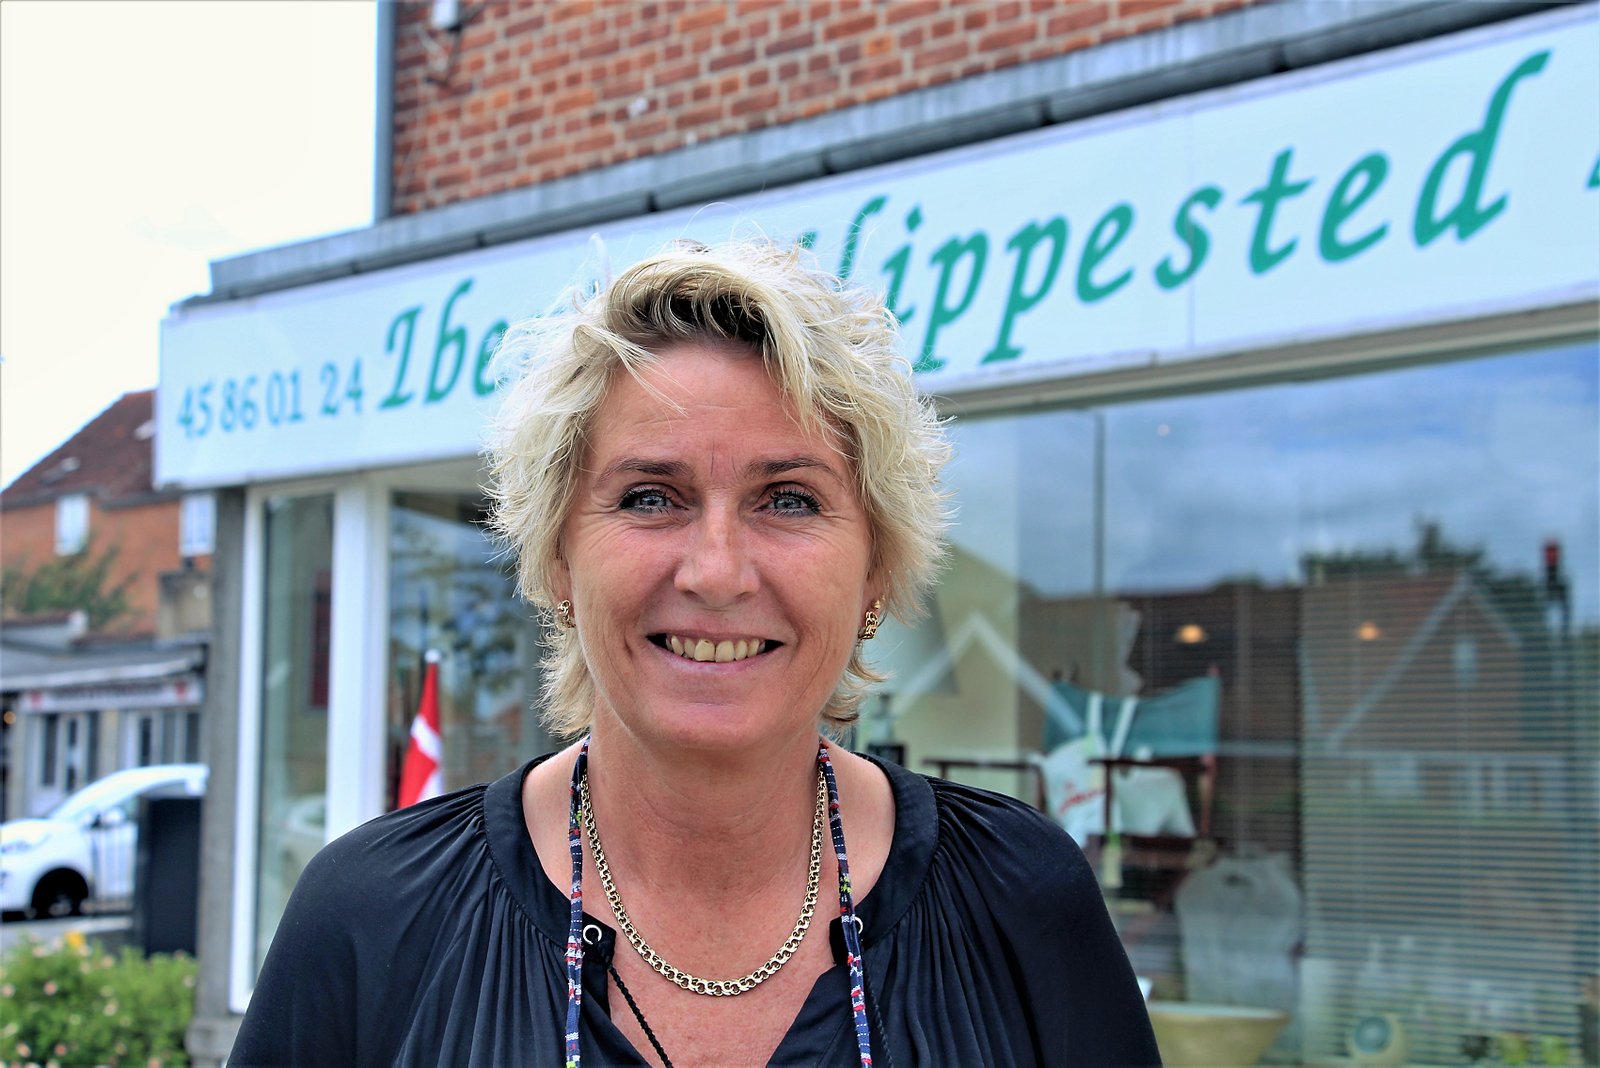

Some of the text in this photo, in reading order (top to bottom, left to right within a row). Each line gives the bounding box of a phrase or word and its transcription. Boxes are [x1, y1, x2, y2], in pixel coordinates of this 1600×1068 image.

[177, 383, 213, 437] 45
[220, 376, 258, 432] 86
[319, 358, 364, 417] 24
[796, 48, 1551, 373] lippested
